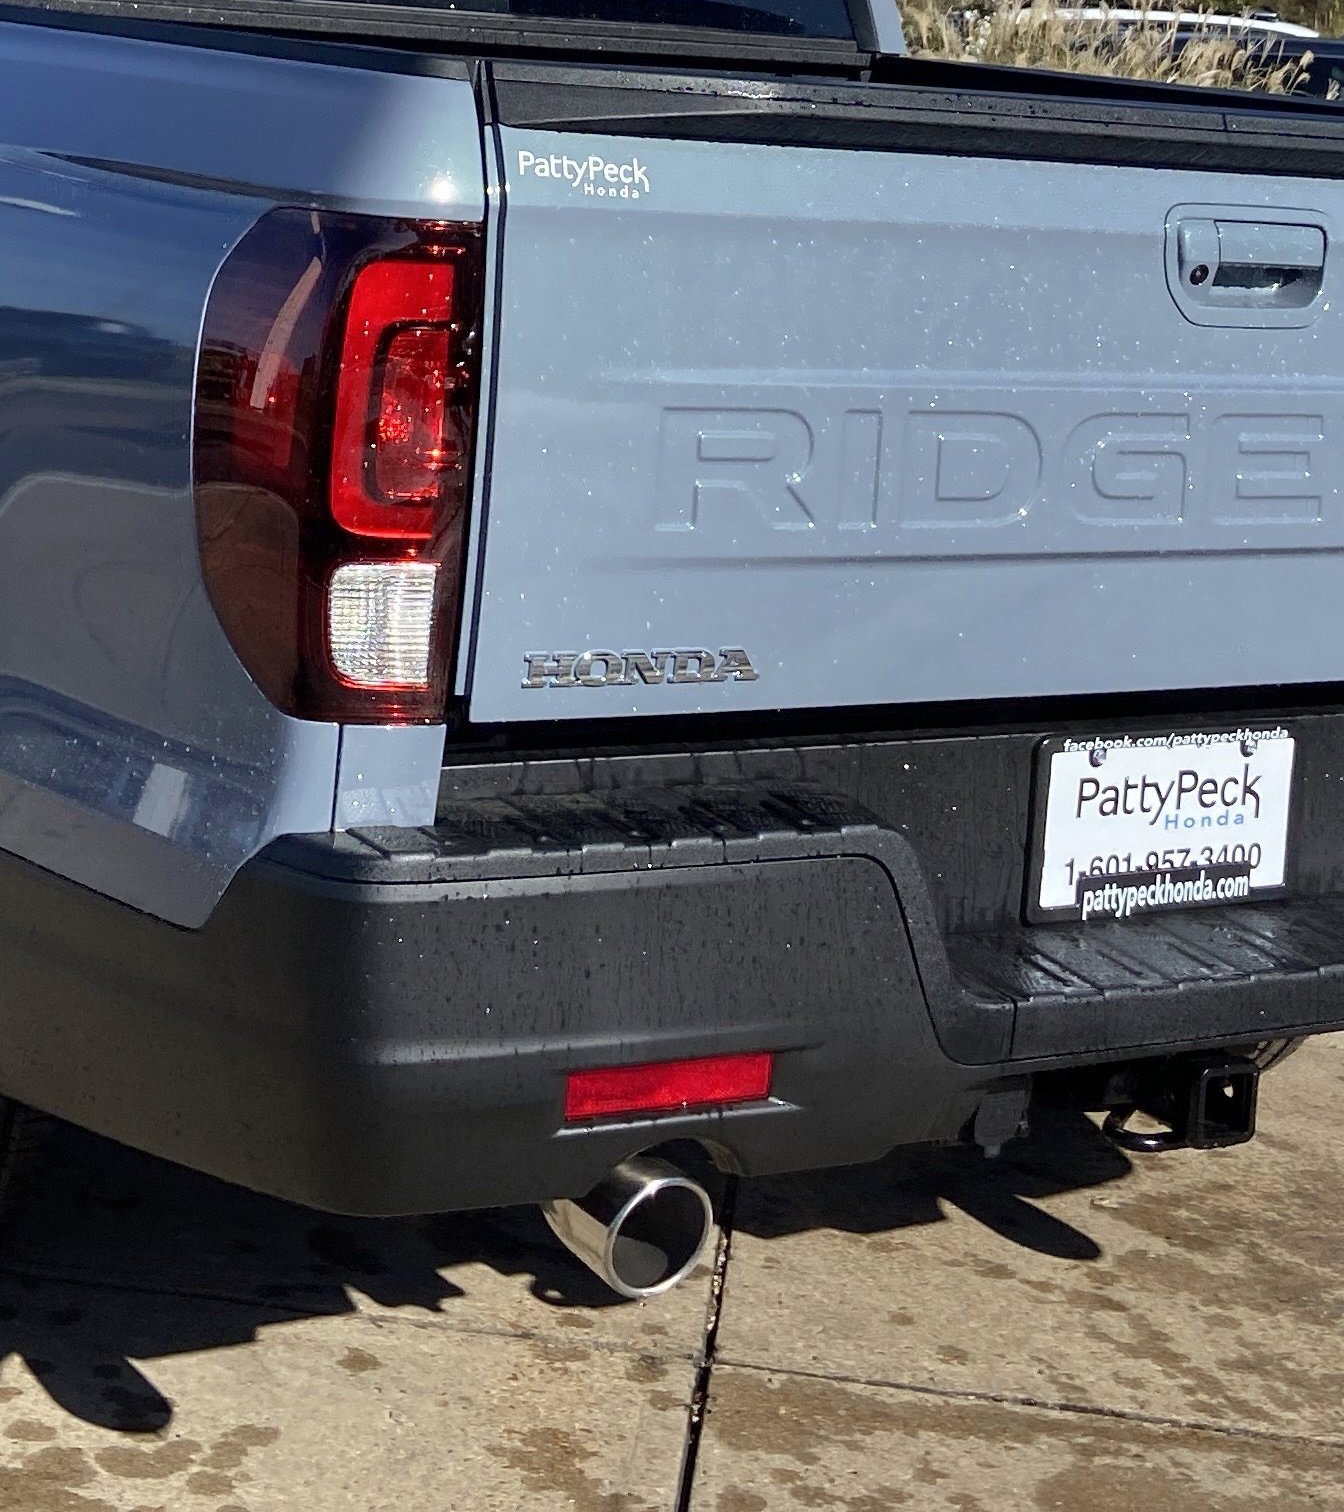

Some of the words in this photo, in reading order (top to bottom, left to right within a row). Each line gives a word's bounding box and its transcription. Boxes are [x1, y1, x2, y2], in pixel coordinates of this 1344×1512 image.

[518, 150, 650, 193] PattyPeck
[583, 182, 640, 199] Honda
[521, 646, 760, 689] HONDA
[1063, 726, 1289, 753] facebook.com/pattypeckhonda
[1076, 763, 1262, 826] PattyPeck
[1164, 809, 1245, 830] Honda
[1082, 870, 1249, 921] pattypeckhonda.com
